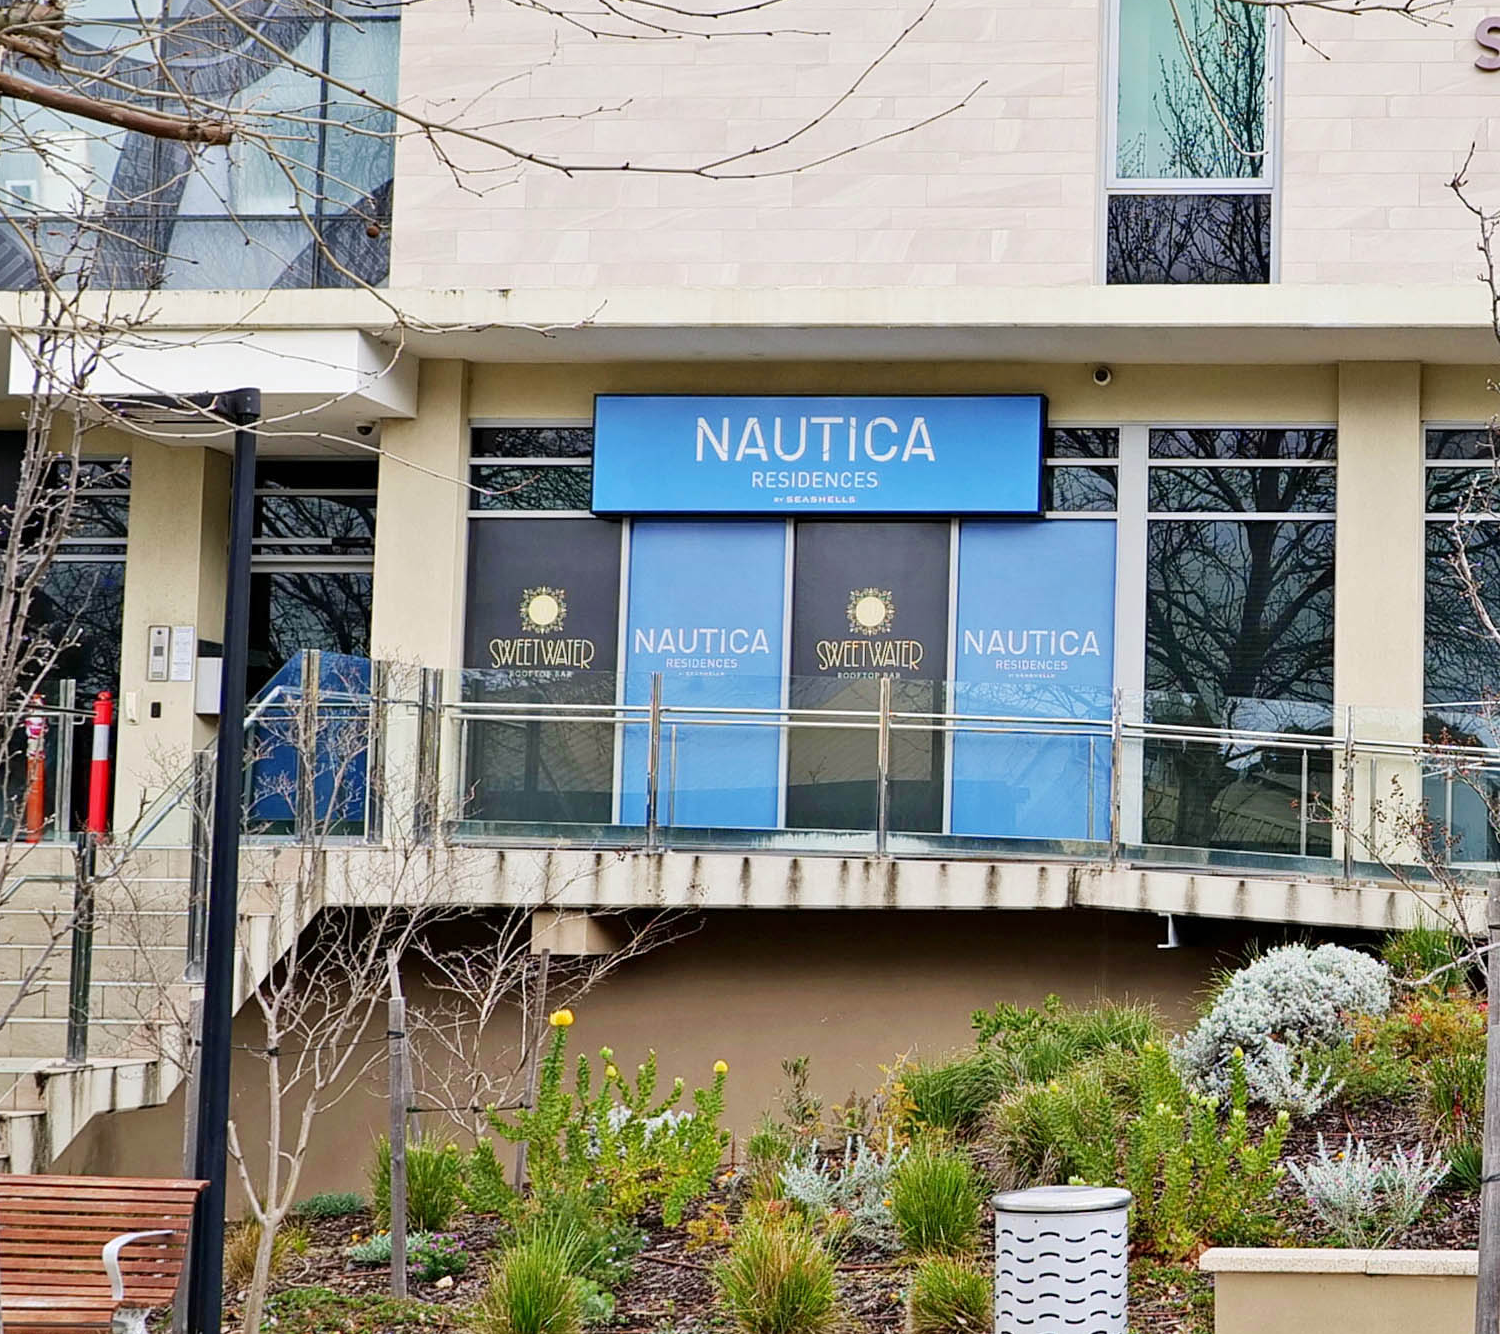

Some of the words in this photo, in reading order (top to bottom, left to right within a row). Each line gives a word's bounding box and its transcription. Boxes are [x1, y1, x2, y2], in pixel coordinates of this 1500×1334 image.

[695, 416, 936, 463] NAUTICA
[751, 471, 879, 489] RESIDENCES
[786, 496, 856, 504] SEASHELLS
[489, 638, 594, 669] SWEETWATER
[634, 628, 770, 655] NAUTICA
[816, 639, 924, 671] SWEETWATER
[963, 629, 1100, 656] NAUTICA
[666, 658, 738, 668] RESIDENCES
[995, 659, 1068, 670] RESIDENCES
